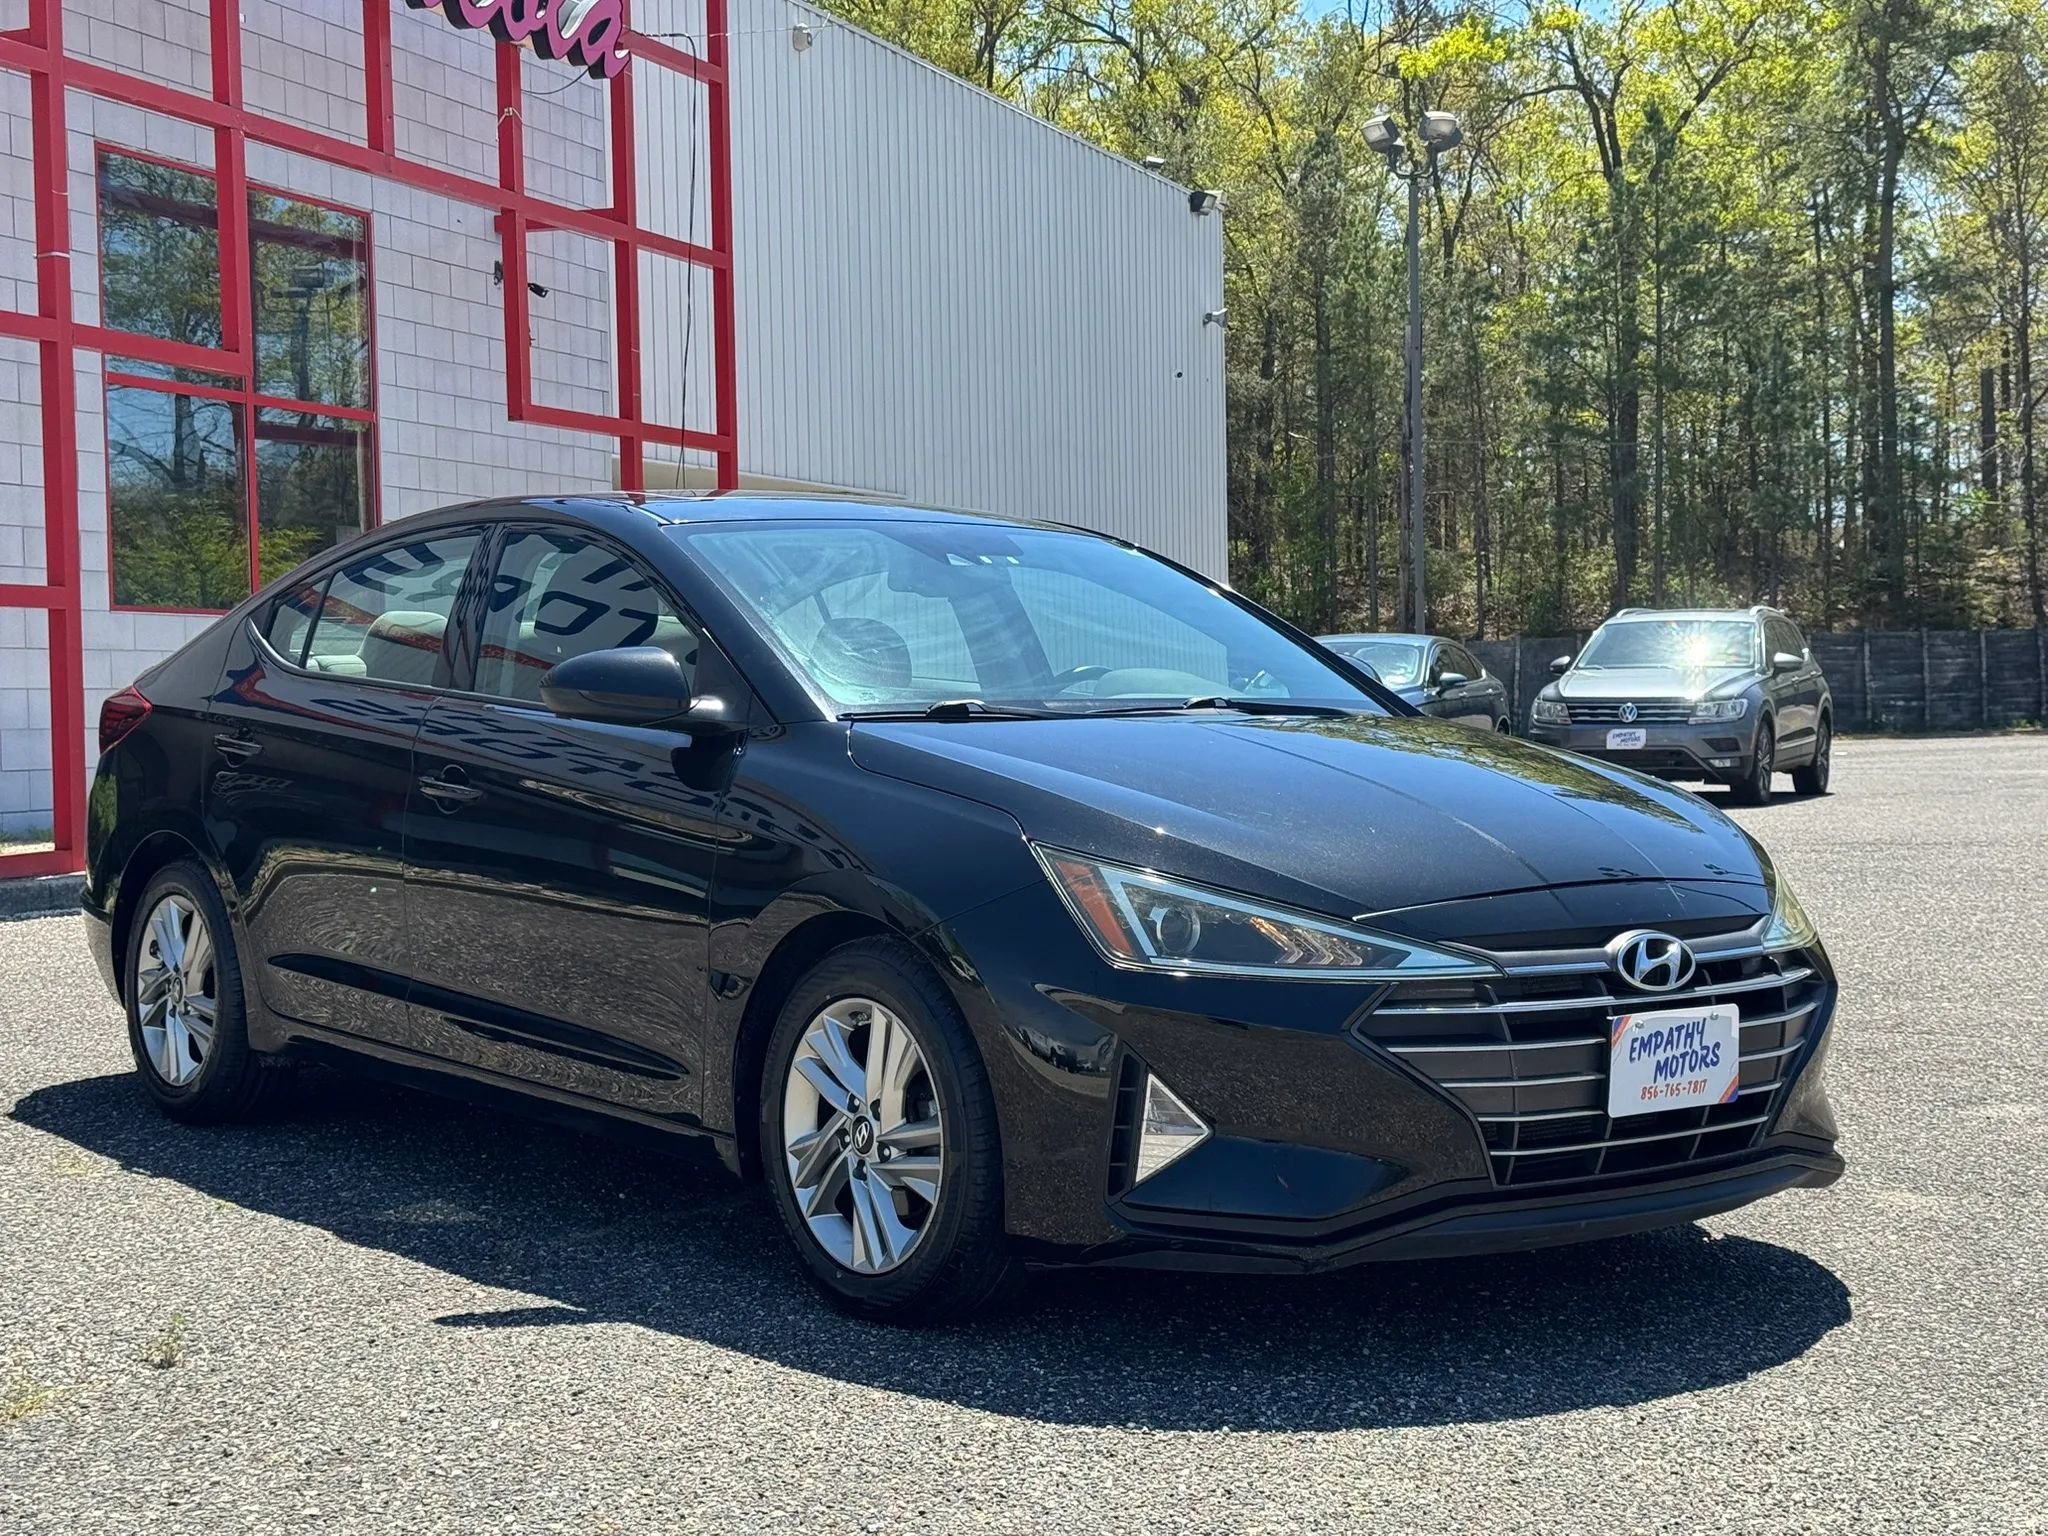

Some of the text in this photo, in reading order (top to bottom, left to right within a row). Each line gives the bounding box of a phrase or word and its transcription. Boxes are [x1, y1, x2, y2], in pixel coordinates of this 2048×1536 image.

[1629, 1017, 1707, 1064] EMPATHY
[1653, 1041, 1721, 1084] MOTORS
[1640, 1079, 1708, 1101] 856-765-7817
